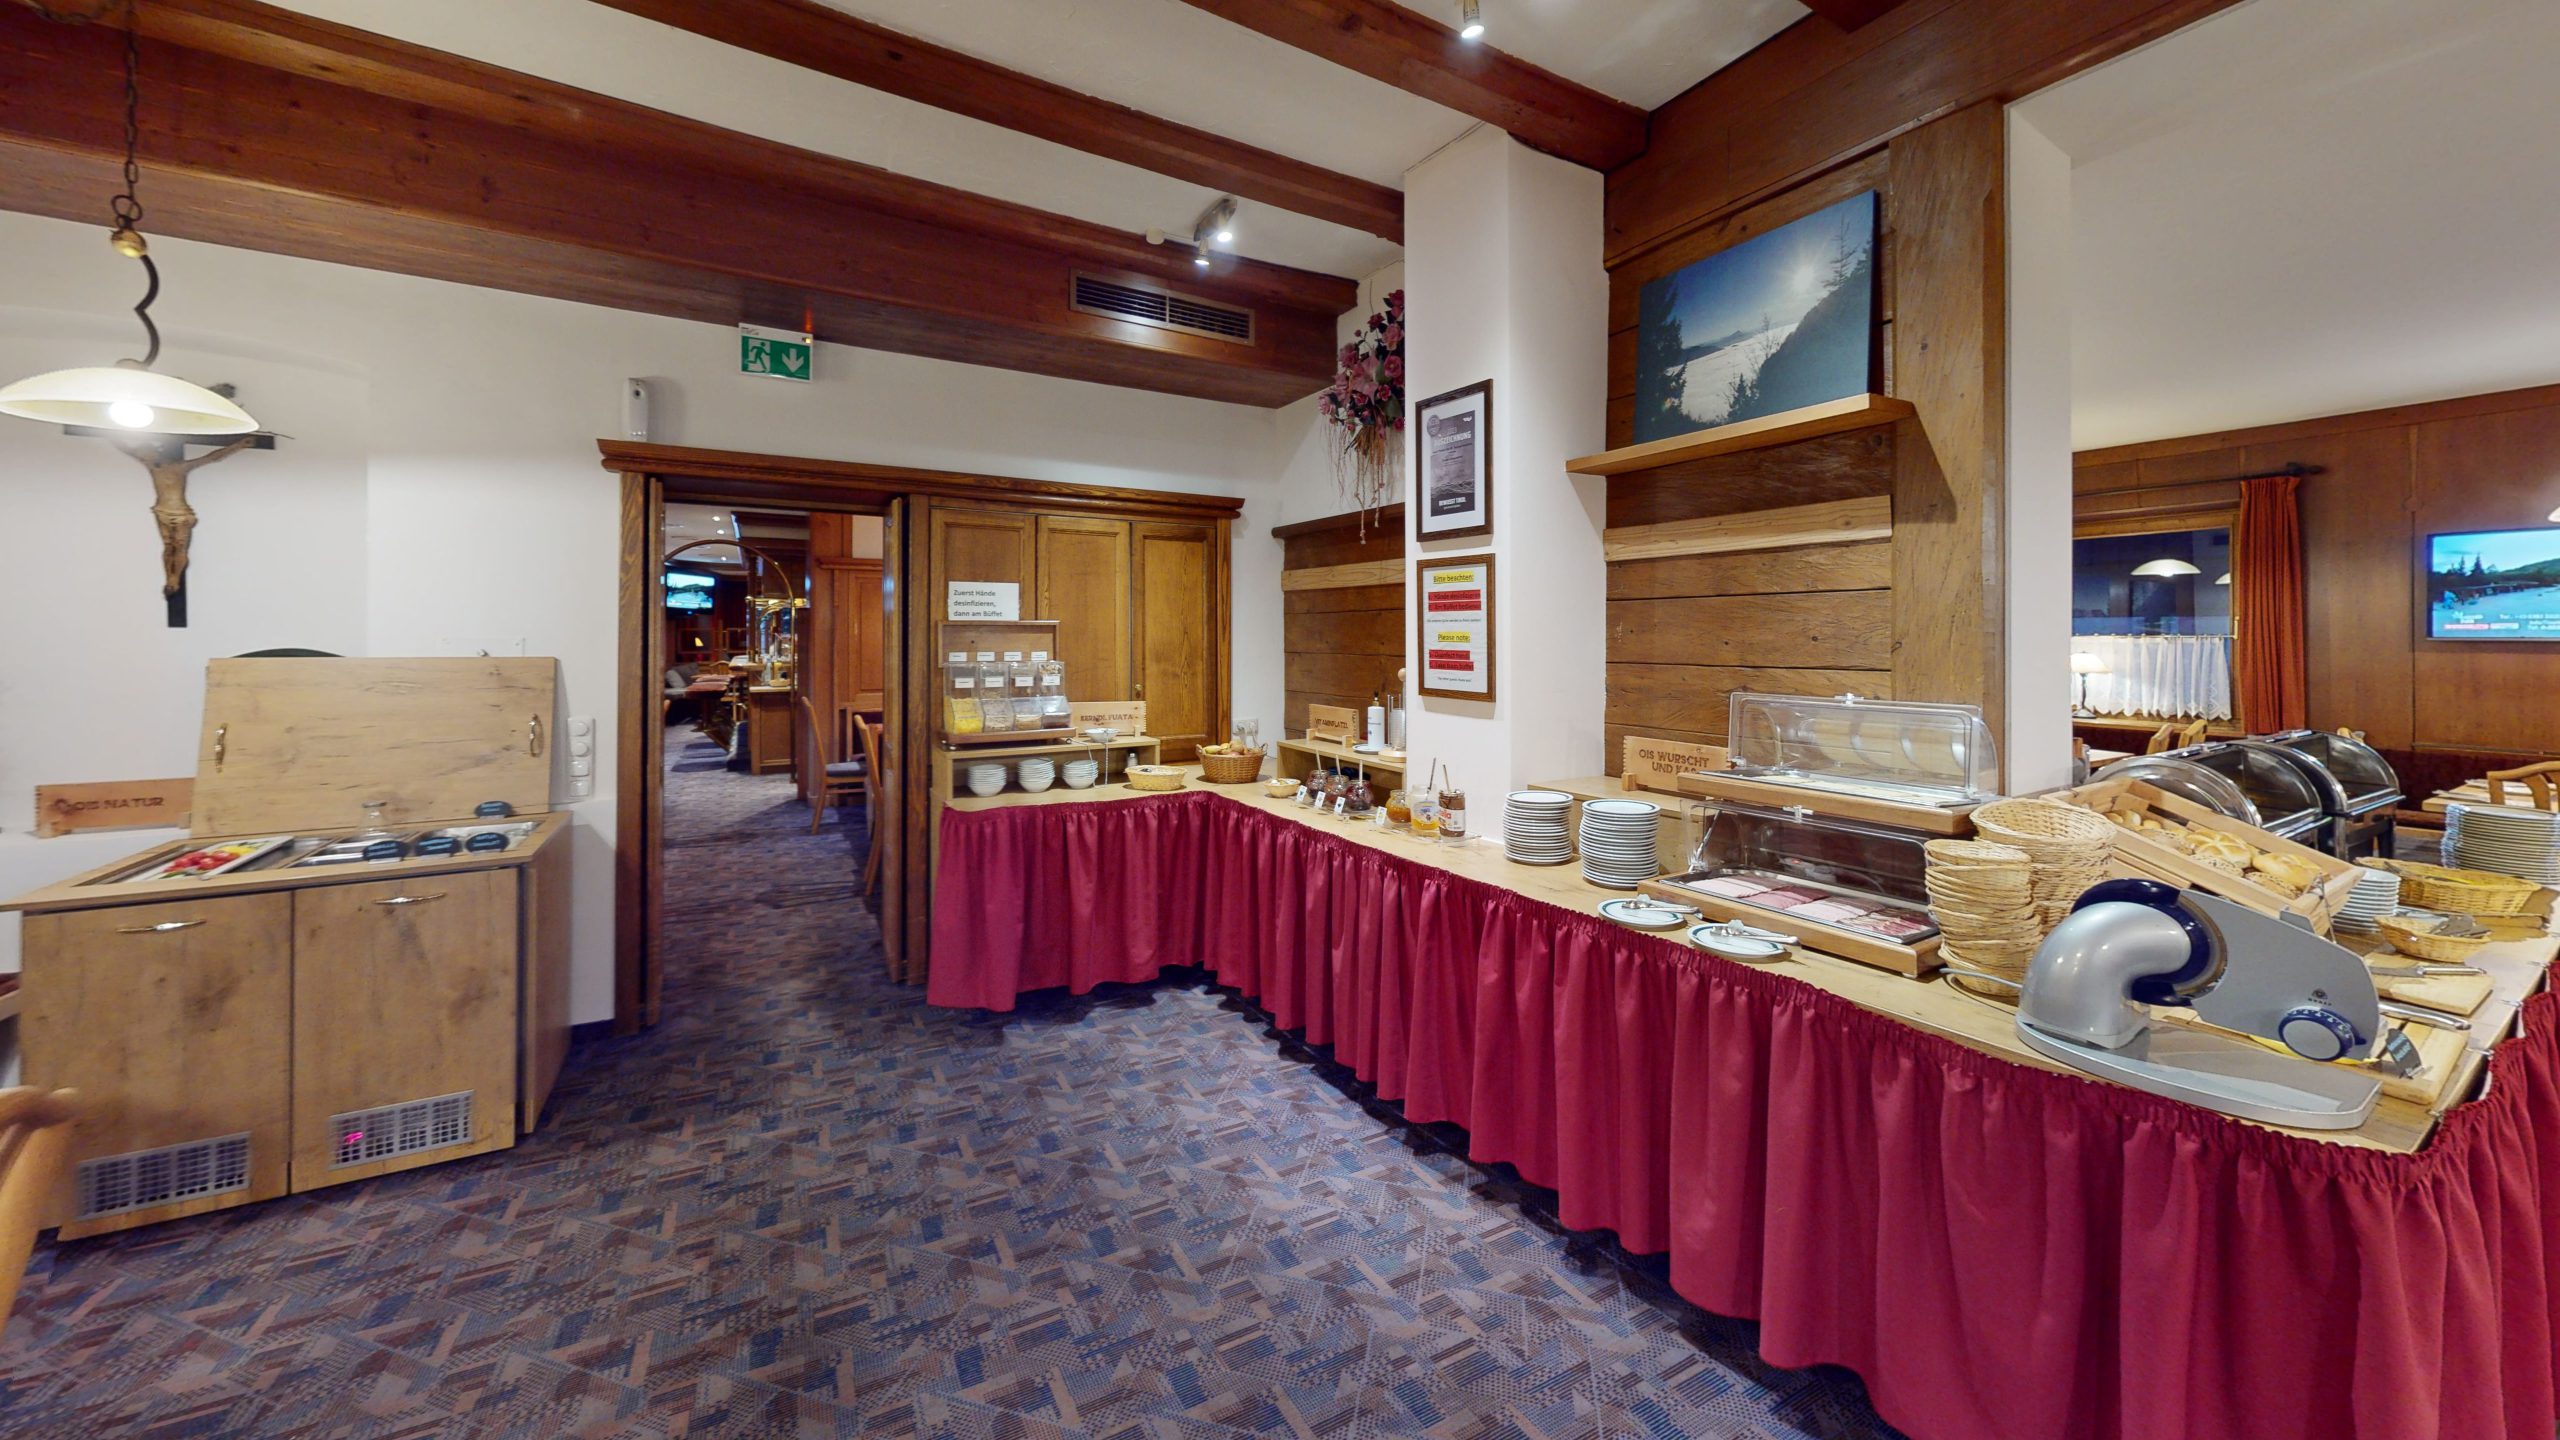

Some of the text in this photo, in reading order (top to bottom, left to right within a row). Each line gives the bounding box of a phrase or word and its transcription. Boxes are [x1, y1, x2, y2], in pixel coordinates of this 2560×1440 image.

[975, 589, 996, 597] Hände
[953, 599, 997, 607] desinfizieren,
[1437, 633, 1471, 642] Please note:
[1638, 748, 1710, 768] OIS WURSCHT
[1651, 761, 1674, 774] UND
[103, 796, 165, 810] NATUR
